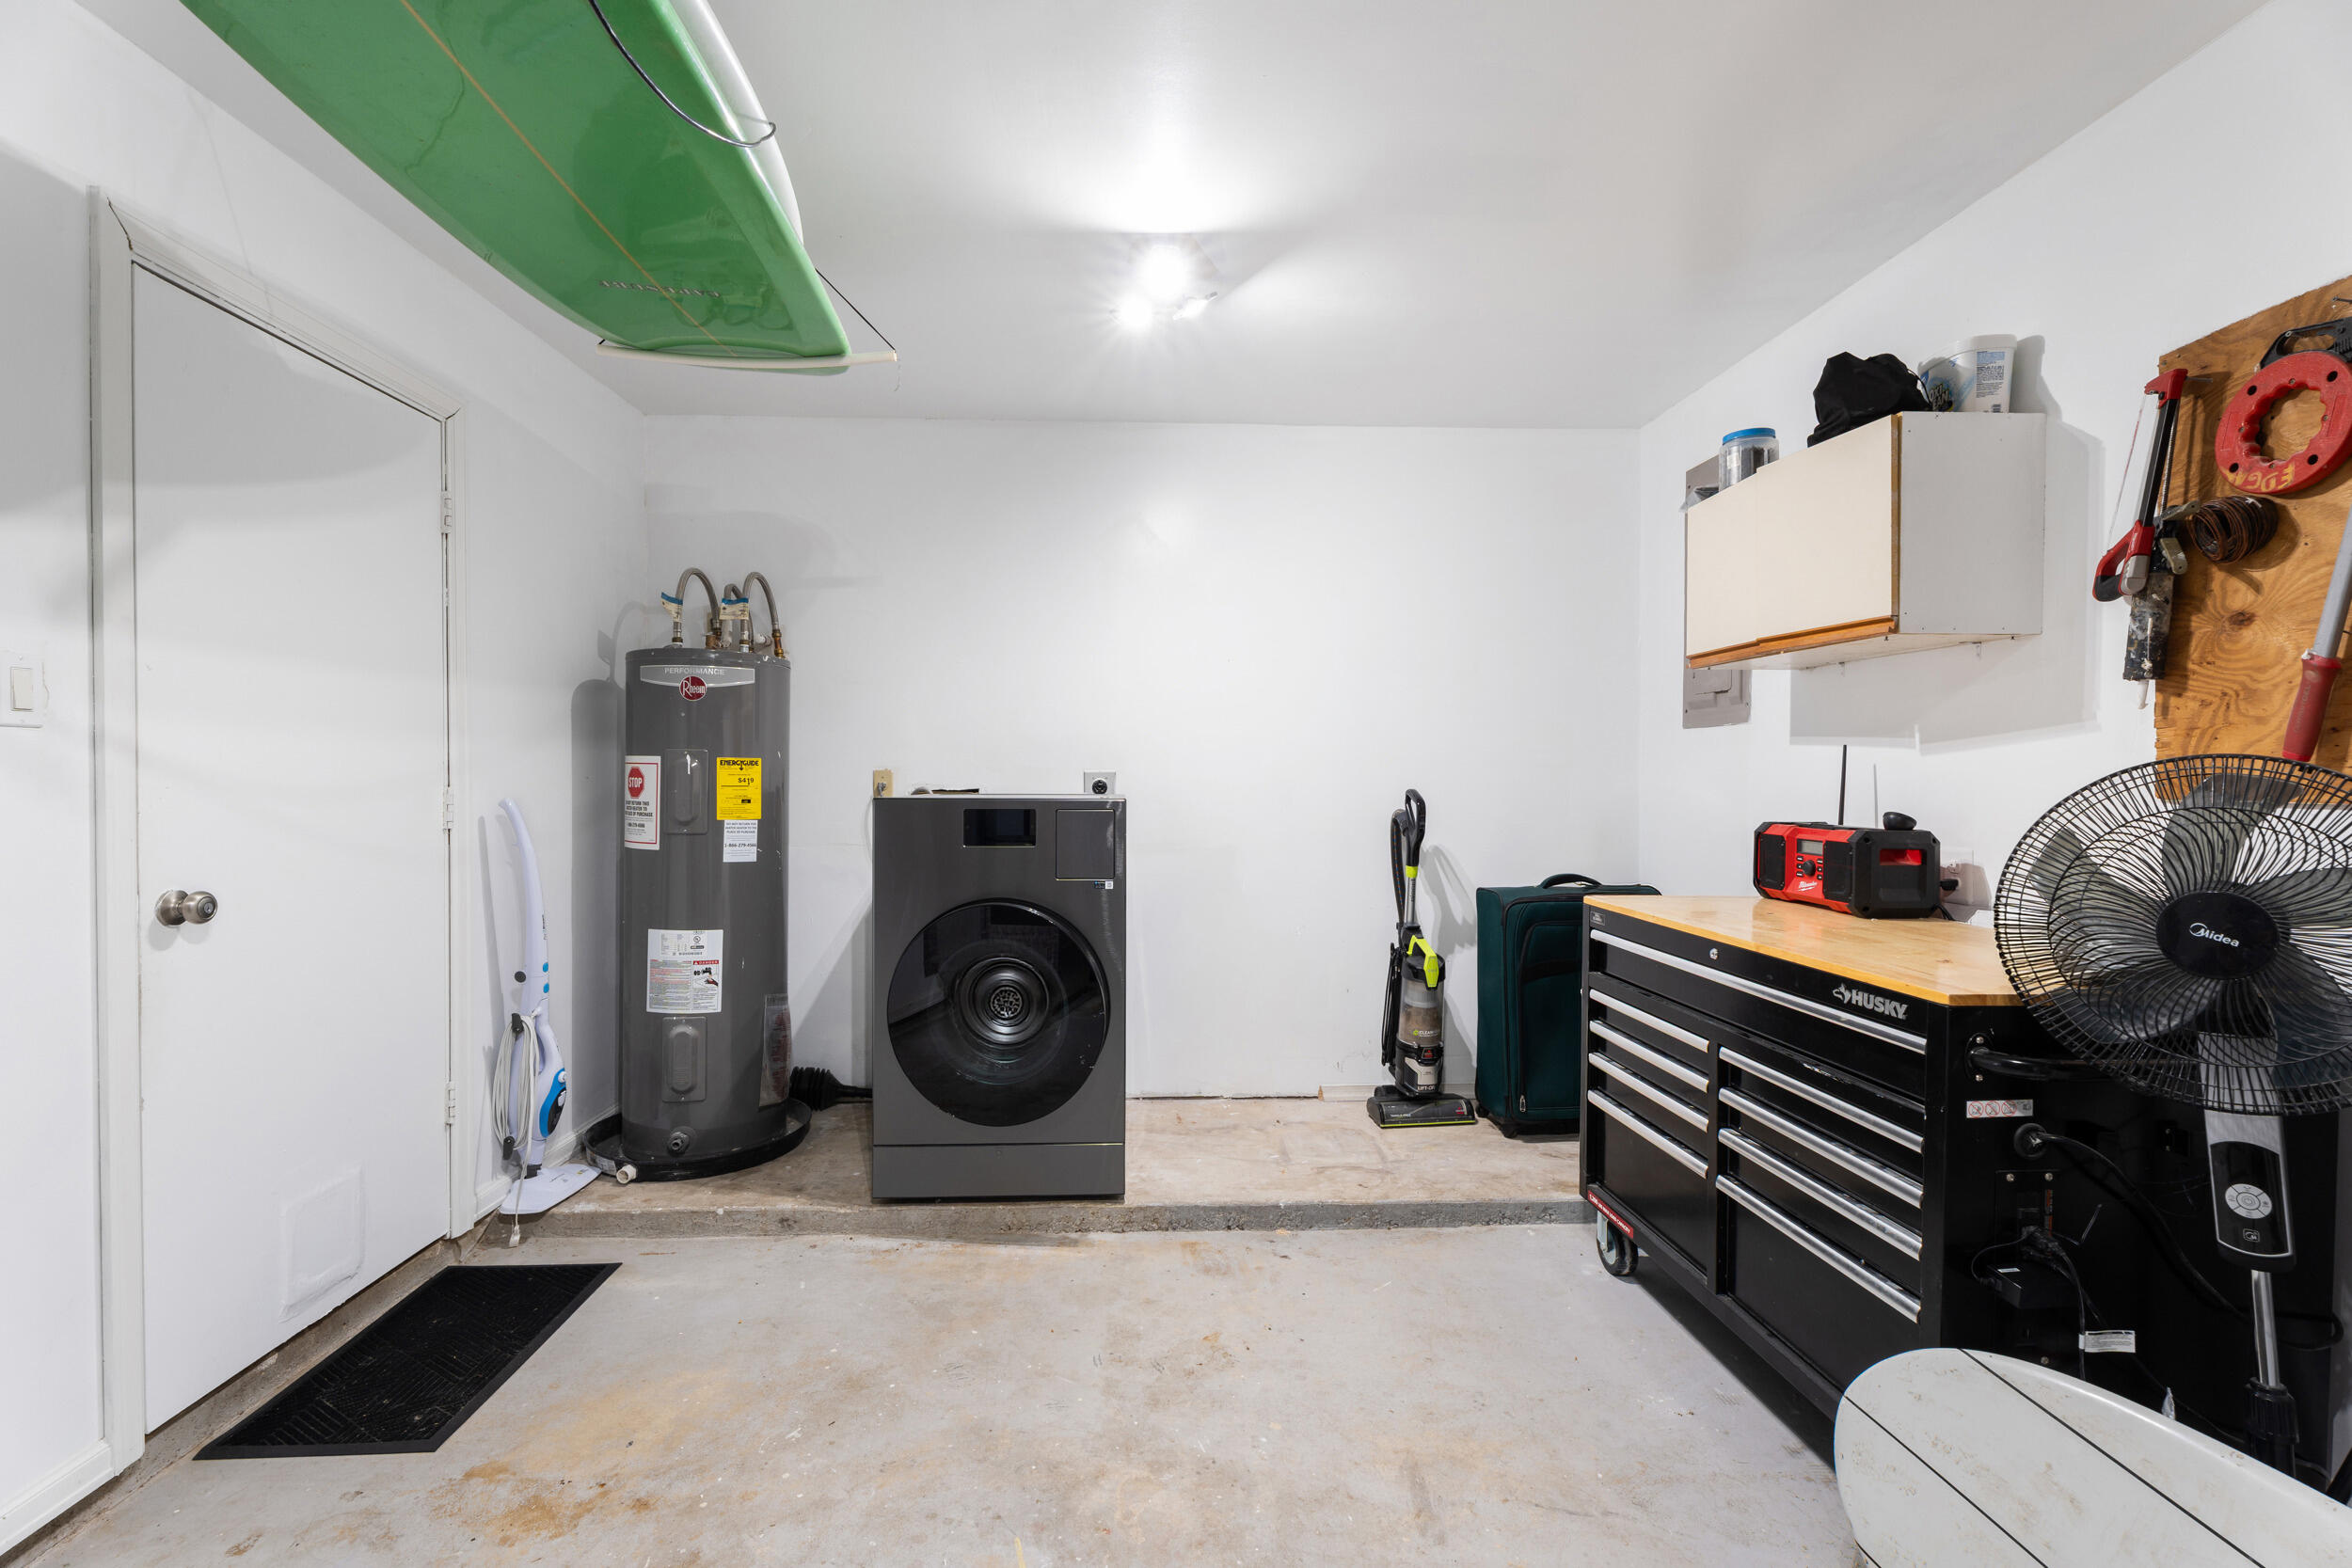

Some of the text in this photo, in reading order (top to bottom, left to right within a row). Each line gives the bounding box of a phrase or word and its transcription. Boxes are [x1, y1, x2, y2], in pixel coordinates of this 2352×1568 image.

[664, 667, 726, 675] PERFORMANCE
[683, 677, 706, 697] Rheem
[628, 777, 643, 788] STOP
[2195, 927, 2239, 947] Midea
[1851, 989, 1909, 1020] HUSKY
